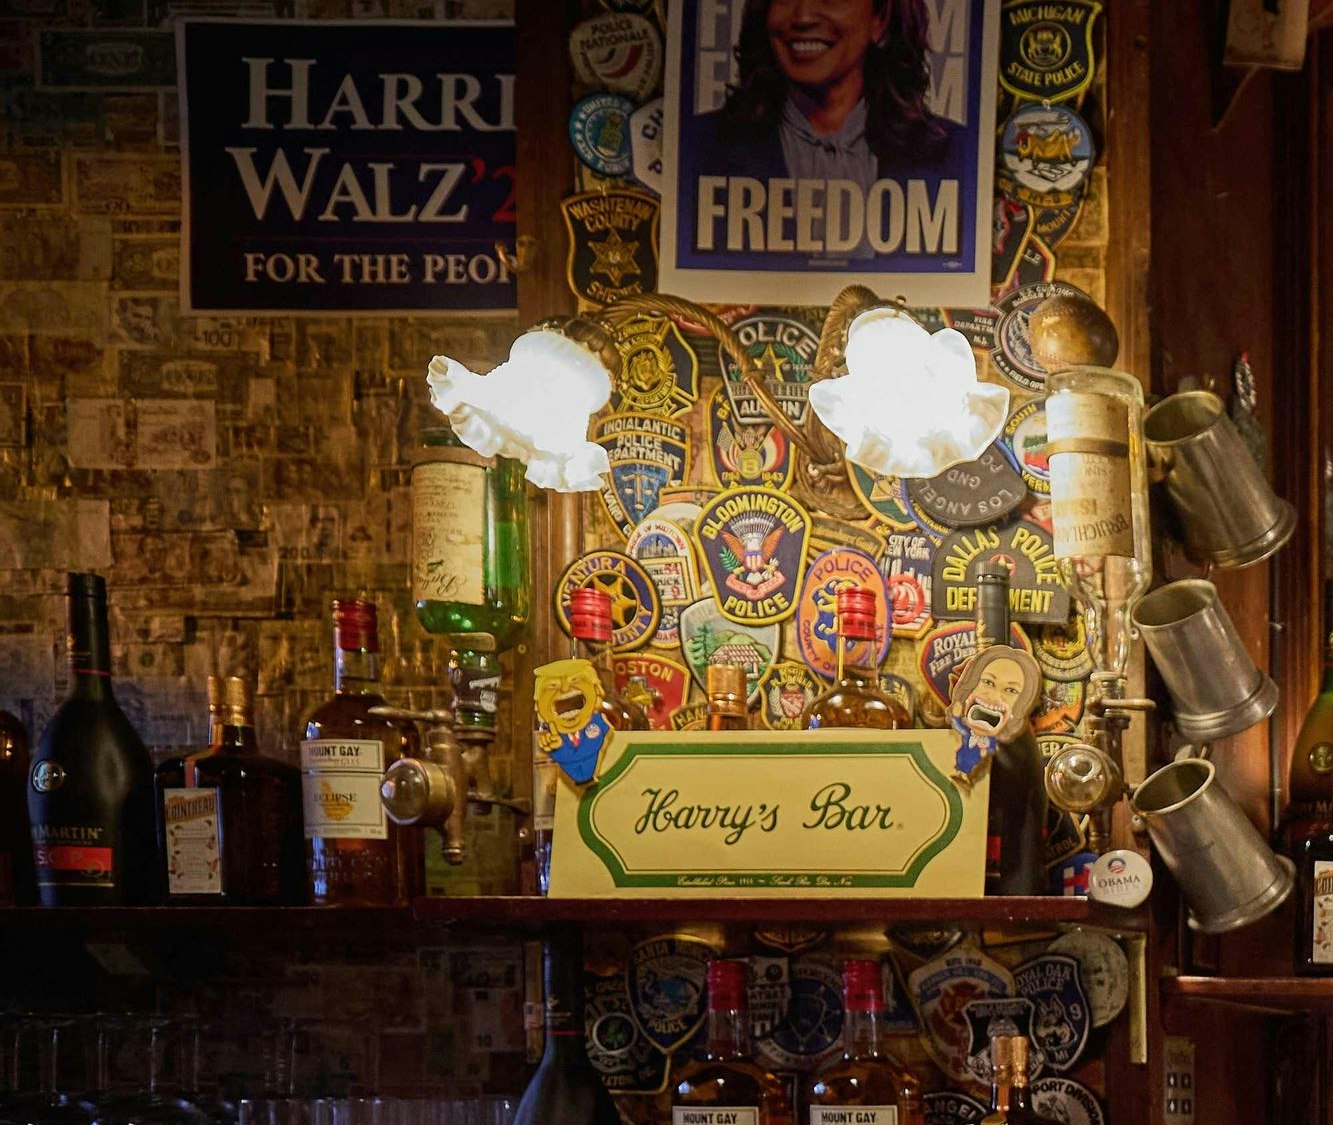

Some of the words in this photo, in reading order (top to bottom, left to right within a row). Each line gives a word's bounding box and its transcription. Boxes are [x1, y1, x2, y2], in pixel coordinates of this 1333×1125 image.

[1009, 6, 1085, 26] MICHIGAN
[1006, 65, 1043, 86] STATE
[1044, 60, 1085, 86] POLICE
[695, 174, 960, 256] FREEDOM
[243, 252, 325, 284] FOR
[333, 253, 411, 285] THE
[737, 321, 820, 359] OLICE
[603, 418, 682, 441] INDIALANTIC
[1005, 404, 1037, 436] SOUTH
[616, 435, 664, 449] POLICE
[607, 447, 682, 471] EPARTMENT
[701, 493, 805, 541] BLOOMINGTON
[942, 524, 1000, 583] DALLAS
[1010, 526, 1061, 587] POLICE
[813, 558, 874, 584] POLICE
[723, 592, 792, 619] POLICE
[614, 660, 673, 684] OSTON
[339, 744, 360, 758] GAY
[801, 781, 896, 832] Bar
[1098, 874, 1142, 890] OBAMA
[1020, 977, 1065, 997] POLICE
[1069, 1002, 1082, 1021] 9
[647, 1020, 689, 1035] POLICE
[1054, 1048, 1069, 1061] MI
[683, 1111, 715, 1125] MOUNT
[716, 1111, 738, 1125] GAY
[820, 1110, 854, 1125] MOUNT
[855, 1111, 878, 1125] GAY
